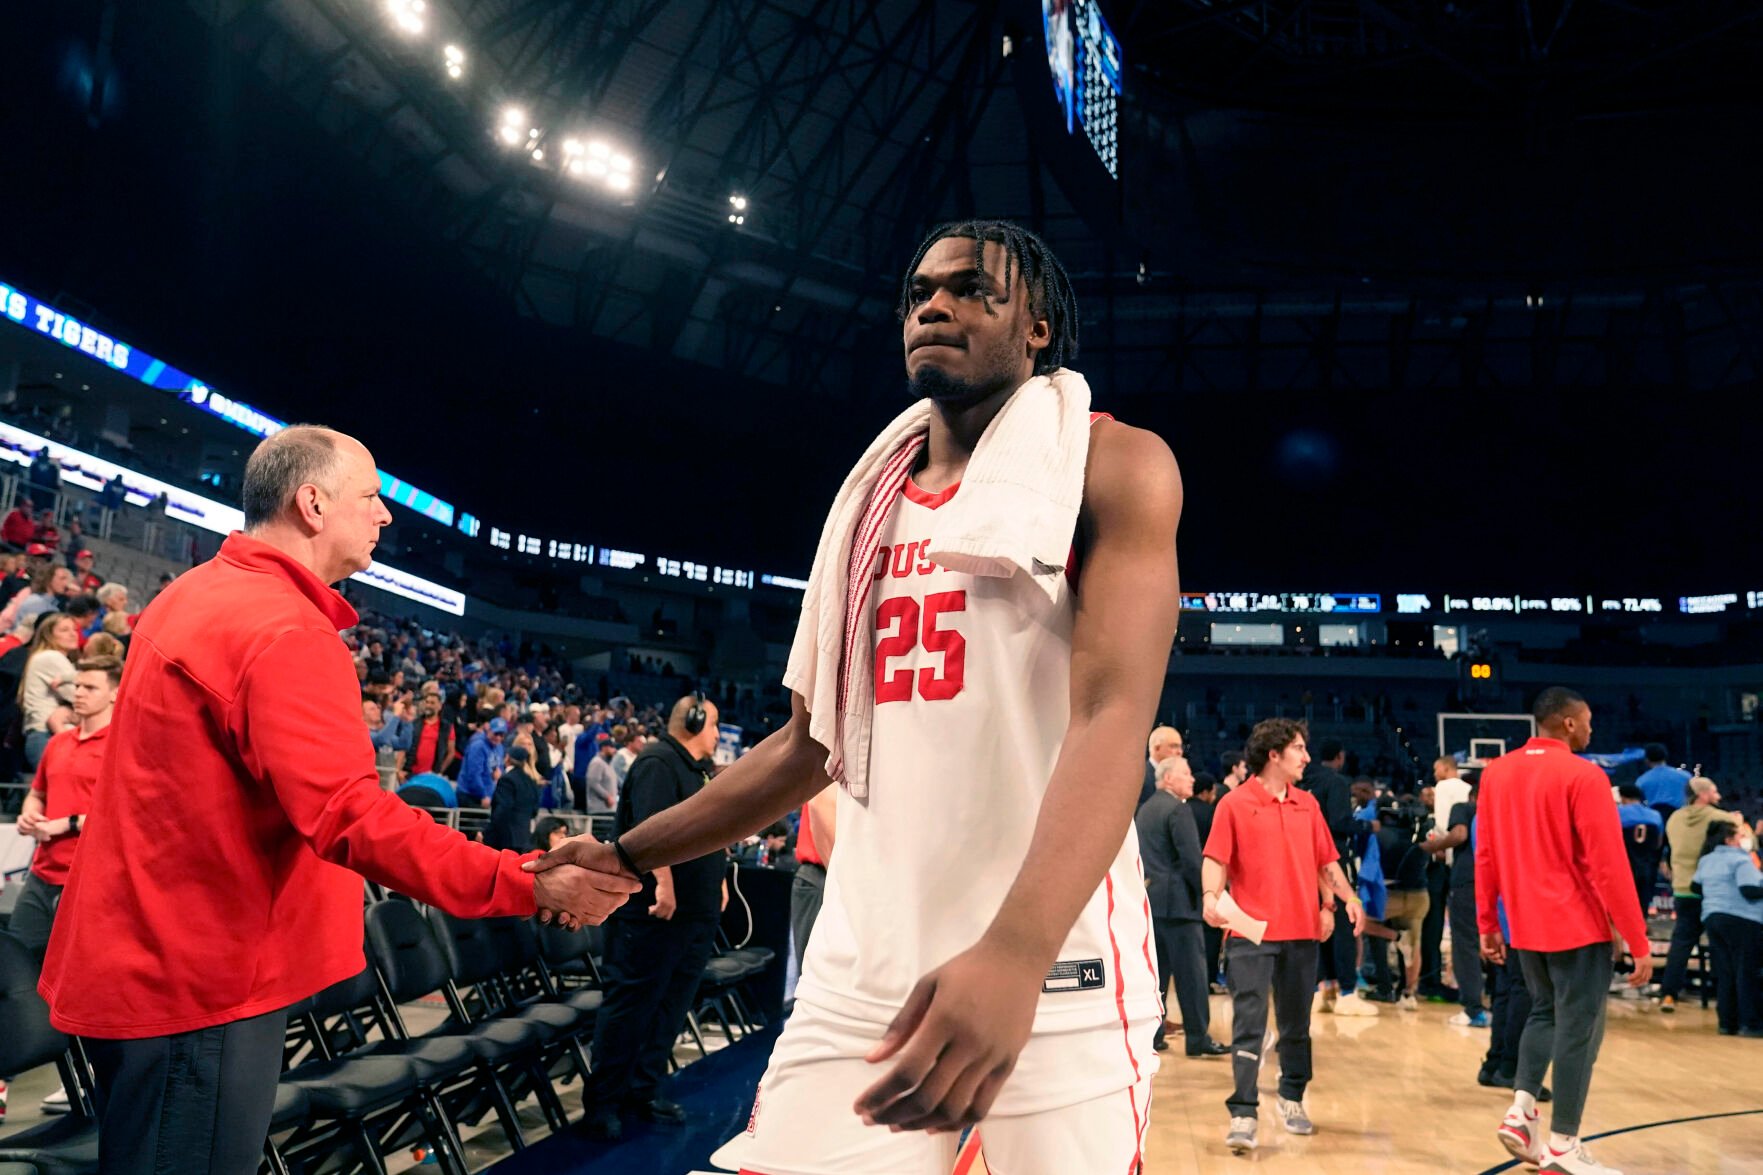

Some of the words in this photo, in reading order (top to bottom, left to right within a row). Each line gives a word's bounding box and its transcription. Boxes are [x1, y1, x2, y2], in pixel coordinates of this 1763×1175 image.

[35, 304, 129, 369] TIGERS
[876, 589, 966, 705] 25
[1082, 968, 1100, 982] XL
